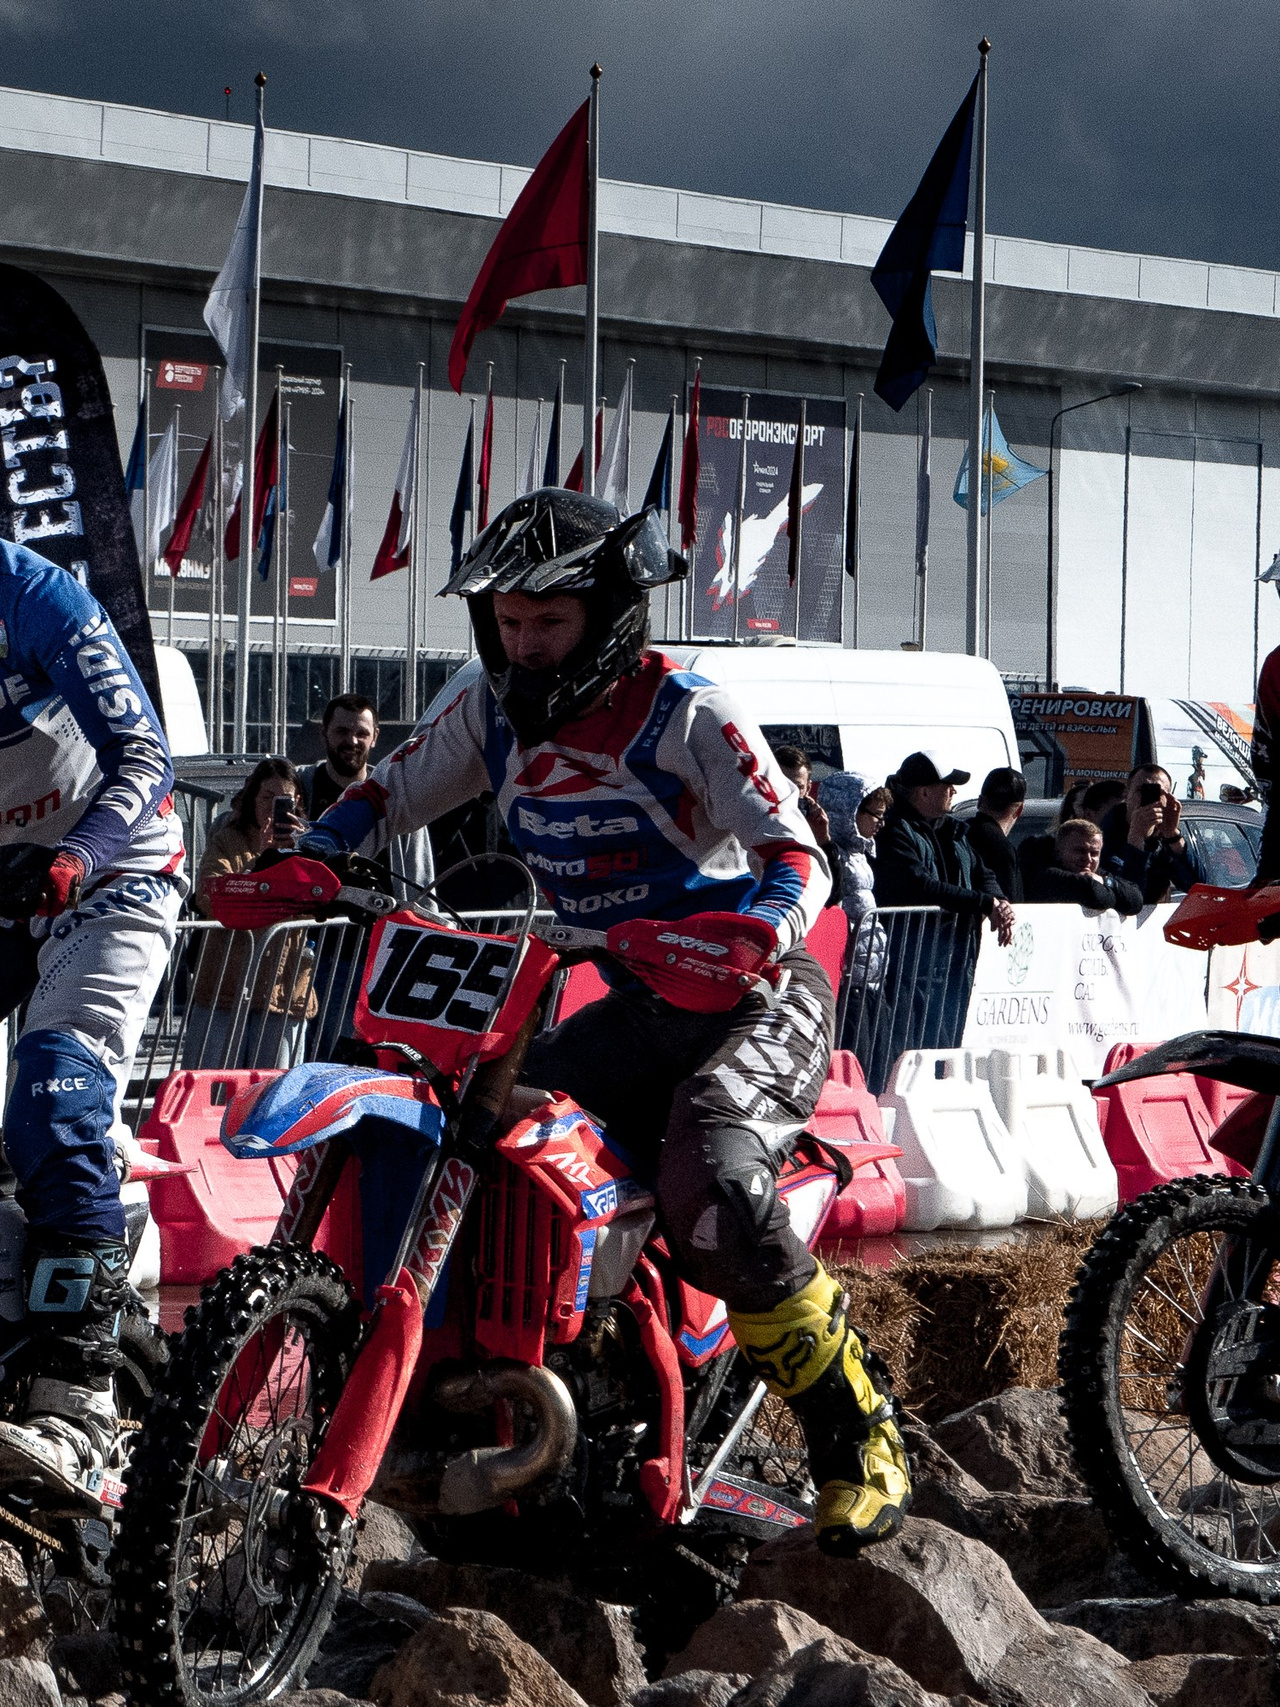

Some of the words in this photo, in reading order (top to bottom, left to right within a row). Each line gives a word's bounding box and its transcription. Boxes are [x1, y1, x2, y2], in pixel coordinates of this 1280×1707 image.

[706, 416, 825, 447] РОСОБОРОНЭКСОРТ
[1010, 699, 1132, 718] РЕНИРОВКИ
[1067, 724, 1117, 733] ВЗРОСЛЫХ
[518, 806, 639, 839] Beta
[976, 997, 1051, 1026] GARDENS
